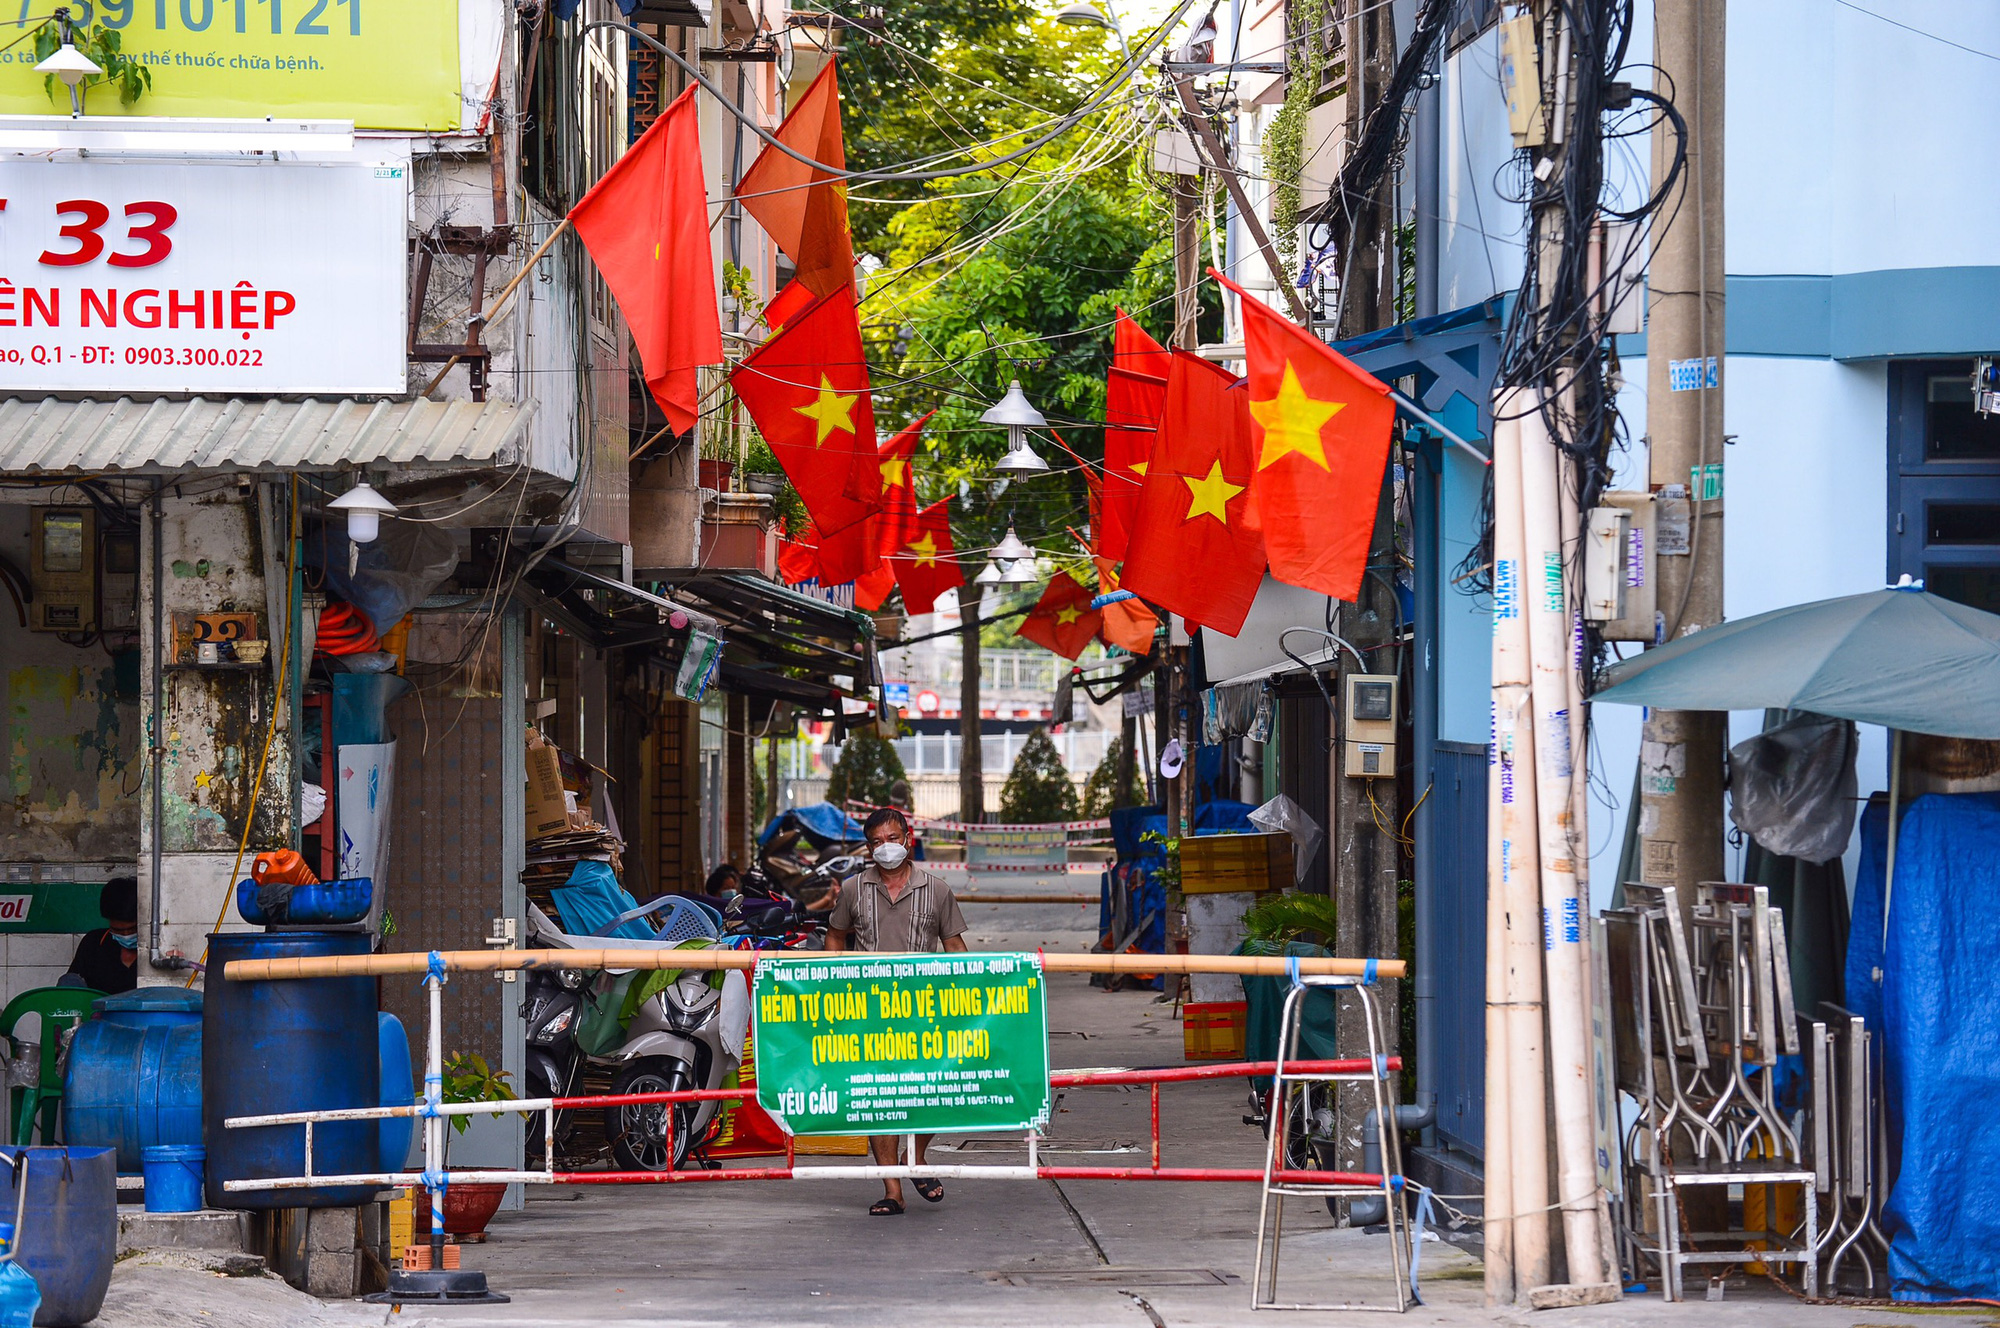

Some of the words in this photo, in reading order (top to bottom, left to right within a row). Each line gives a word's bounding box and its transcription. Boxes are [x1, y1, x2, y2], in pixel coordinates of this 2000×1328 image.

[18, 49, 35, 63] tá
[142, 50, 171, 65] thế
[174, 51, 225, 67] thuốc
[229, 55, 271, 69] chữa
[275, 56, 325, 73] bệnh.
[38, 199, 178, 268] 33
[80, 281, 296, 341] NGHIỆP
[31, 345, 62, 366] Q.1
[82, 346, 115, 364] ĐT:
[125, 347, 263, 366] 0903.300.022
[774, 967, 792, 981] BAN
[794, 963, 809, 981] CHỈ
[811, 965, 829, 983] ĐẠO
[831, 963, 861, 980] PHÒNG
[862, 960, 891, 979] CHỐNG
[894, 962, 914, 979] DỊCH
[916, 959, 951, 977] PHƯỜNG
[953, 960, 965, 975] ĐA
[967, 960, 984, 975] KAO
[1015, 959, 1021, 973] 1
[761, 985, 797, 1023] HẺM
[799, 990, 821, 1027] TỰ
[824, 983, 868, 1024] QUẢN
[915, 983, 936, 1023] VỆ
[938, 983, 982, 1017] VÙNG
[811, 1028, 860, 1066] (VÙNG
[864, 1026, 918, 1061] KHÔNG
[922, 1024, 943, 1059] CÓ
[947, 1028, 990, 1065] DỊCH)
[850, 1072, 874, 1084] NGƯỜI
[875, 1072, 898, 1083] NGOÀI
[900, 1070, 925, 1082] KHÔNG
[926, 1070, 938, 1082] TỰ
[944, 1069, 959, 1080] VÀO
[961, 1069, 976, 1080] KHU
[977, 1069, 993, 1081] VỰC
[994, 1067, 1010, 1079] NÀY
[777, 1087, 805, 1116] YÊU
[808, 1083, 838, 1115] CẦU
[850, 1086, 878, 1097] SHIPER
[879, 1086, 897, 1096] GIAO
[898, 1084, 919, 1095] HÀNG
[937, 1082, 961, 1094] NGOÀI
[873, 1098, 894, 1109] HÀNH
[861, 1112, 873, 1123] THỊ
